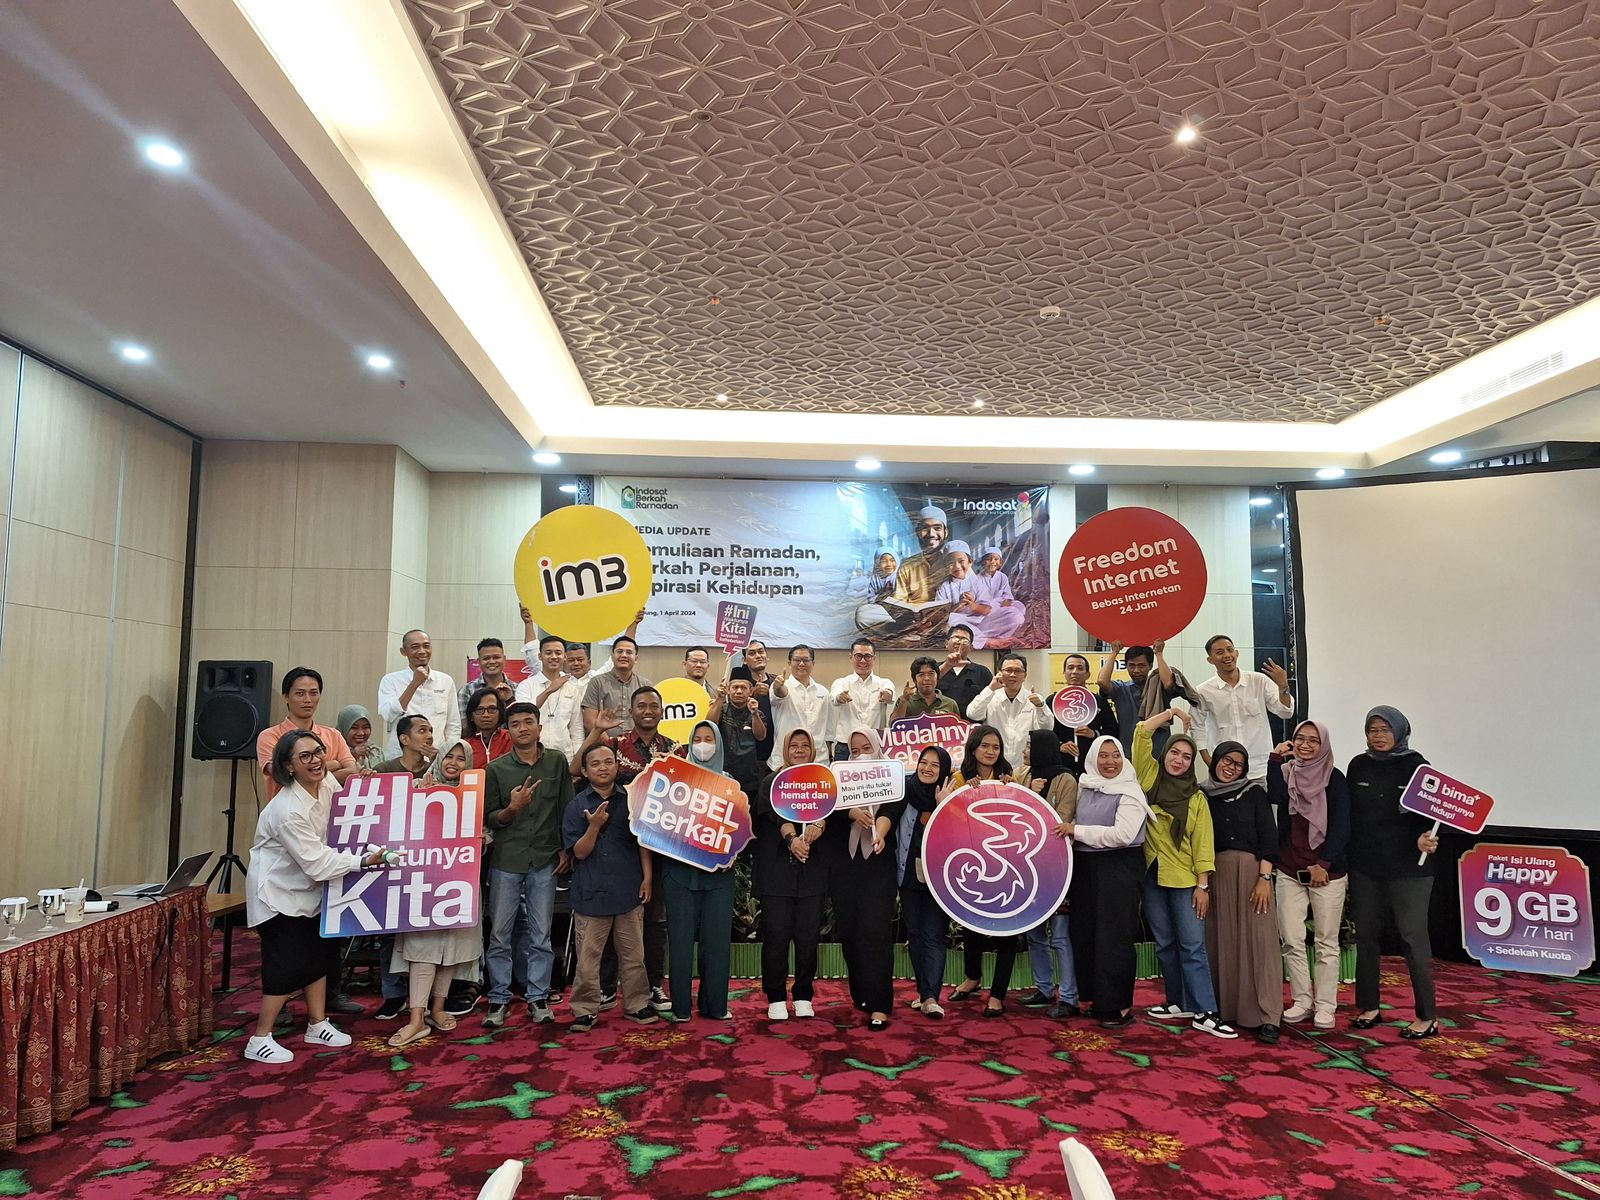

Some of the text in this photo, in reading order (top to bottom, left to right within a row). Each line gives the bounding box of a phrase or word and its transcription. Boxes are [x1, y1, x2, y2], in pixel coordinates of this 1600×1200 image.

[635, 487, 668, 495] Indosat
[635, 494, 667, 502] Berkah
[635, 502, 679, 510] Ramadan
[963, 498, 1017, 511] indosat
[667, 526, 711, 536] UPDATE
[647, 542, 821, 561] muliaan Ramadan,
[1073, 538, 1178, 575] Freedom
[652, 560, 800, 580] rkah Perjalanan,
[1083, 558, 1180, 595] Internet
[540, 556, 627, 603] im3
[651, 578, 804, 599] pirasi Kehidupan
[1091, 583, 1181, 610] Bebas Internetan
[724, 604, 751, 619] #Ini
[1120, 600, 1158, 615] 24 Jam
[720, 621, 747, 635] Kita
[661, 703, 697, 720] m3
[839, 765, 891, 783] BonsTri
[778, 780, 831, 790] Jaringan Tri
[647, 771, 740, 830] DOBEL
[781, 791, 829, 799] hemat dan
[842, 788, 895, 802] poin BonsTri.
[333, 773, 479, 845] #Ini
[790, 801, 819, 811] cepat.
[1417, 790, 1475, 818] Akses serunya
[1430, 804, 1456, 820] hidup!
[640, 797, 734, 854] Berkah
[1487, 854, 1556, 868] Paket Isi Ulang
[1486, 863, 1558, 886] Happy
[325, 869, 474, 934] Kita
[1474, 887, 1579, 936] 9 GB
[1523, 925, 1574, 941] /7 hari
[1540, 950, 1572, 961] Kuota
